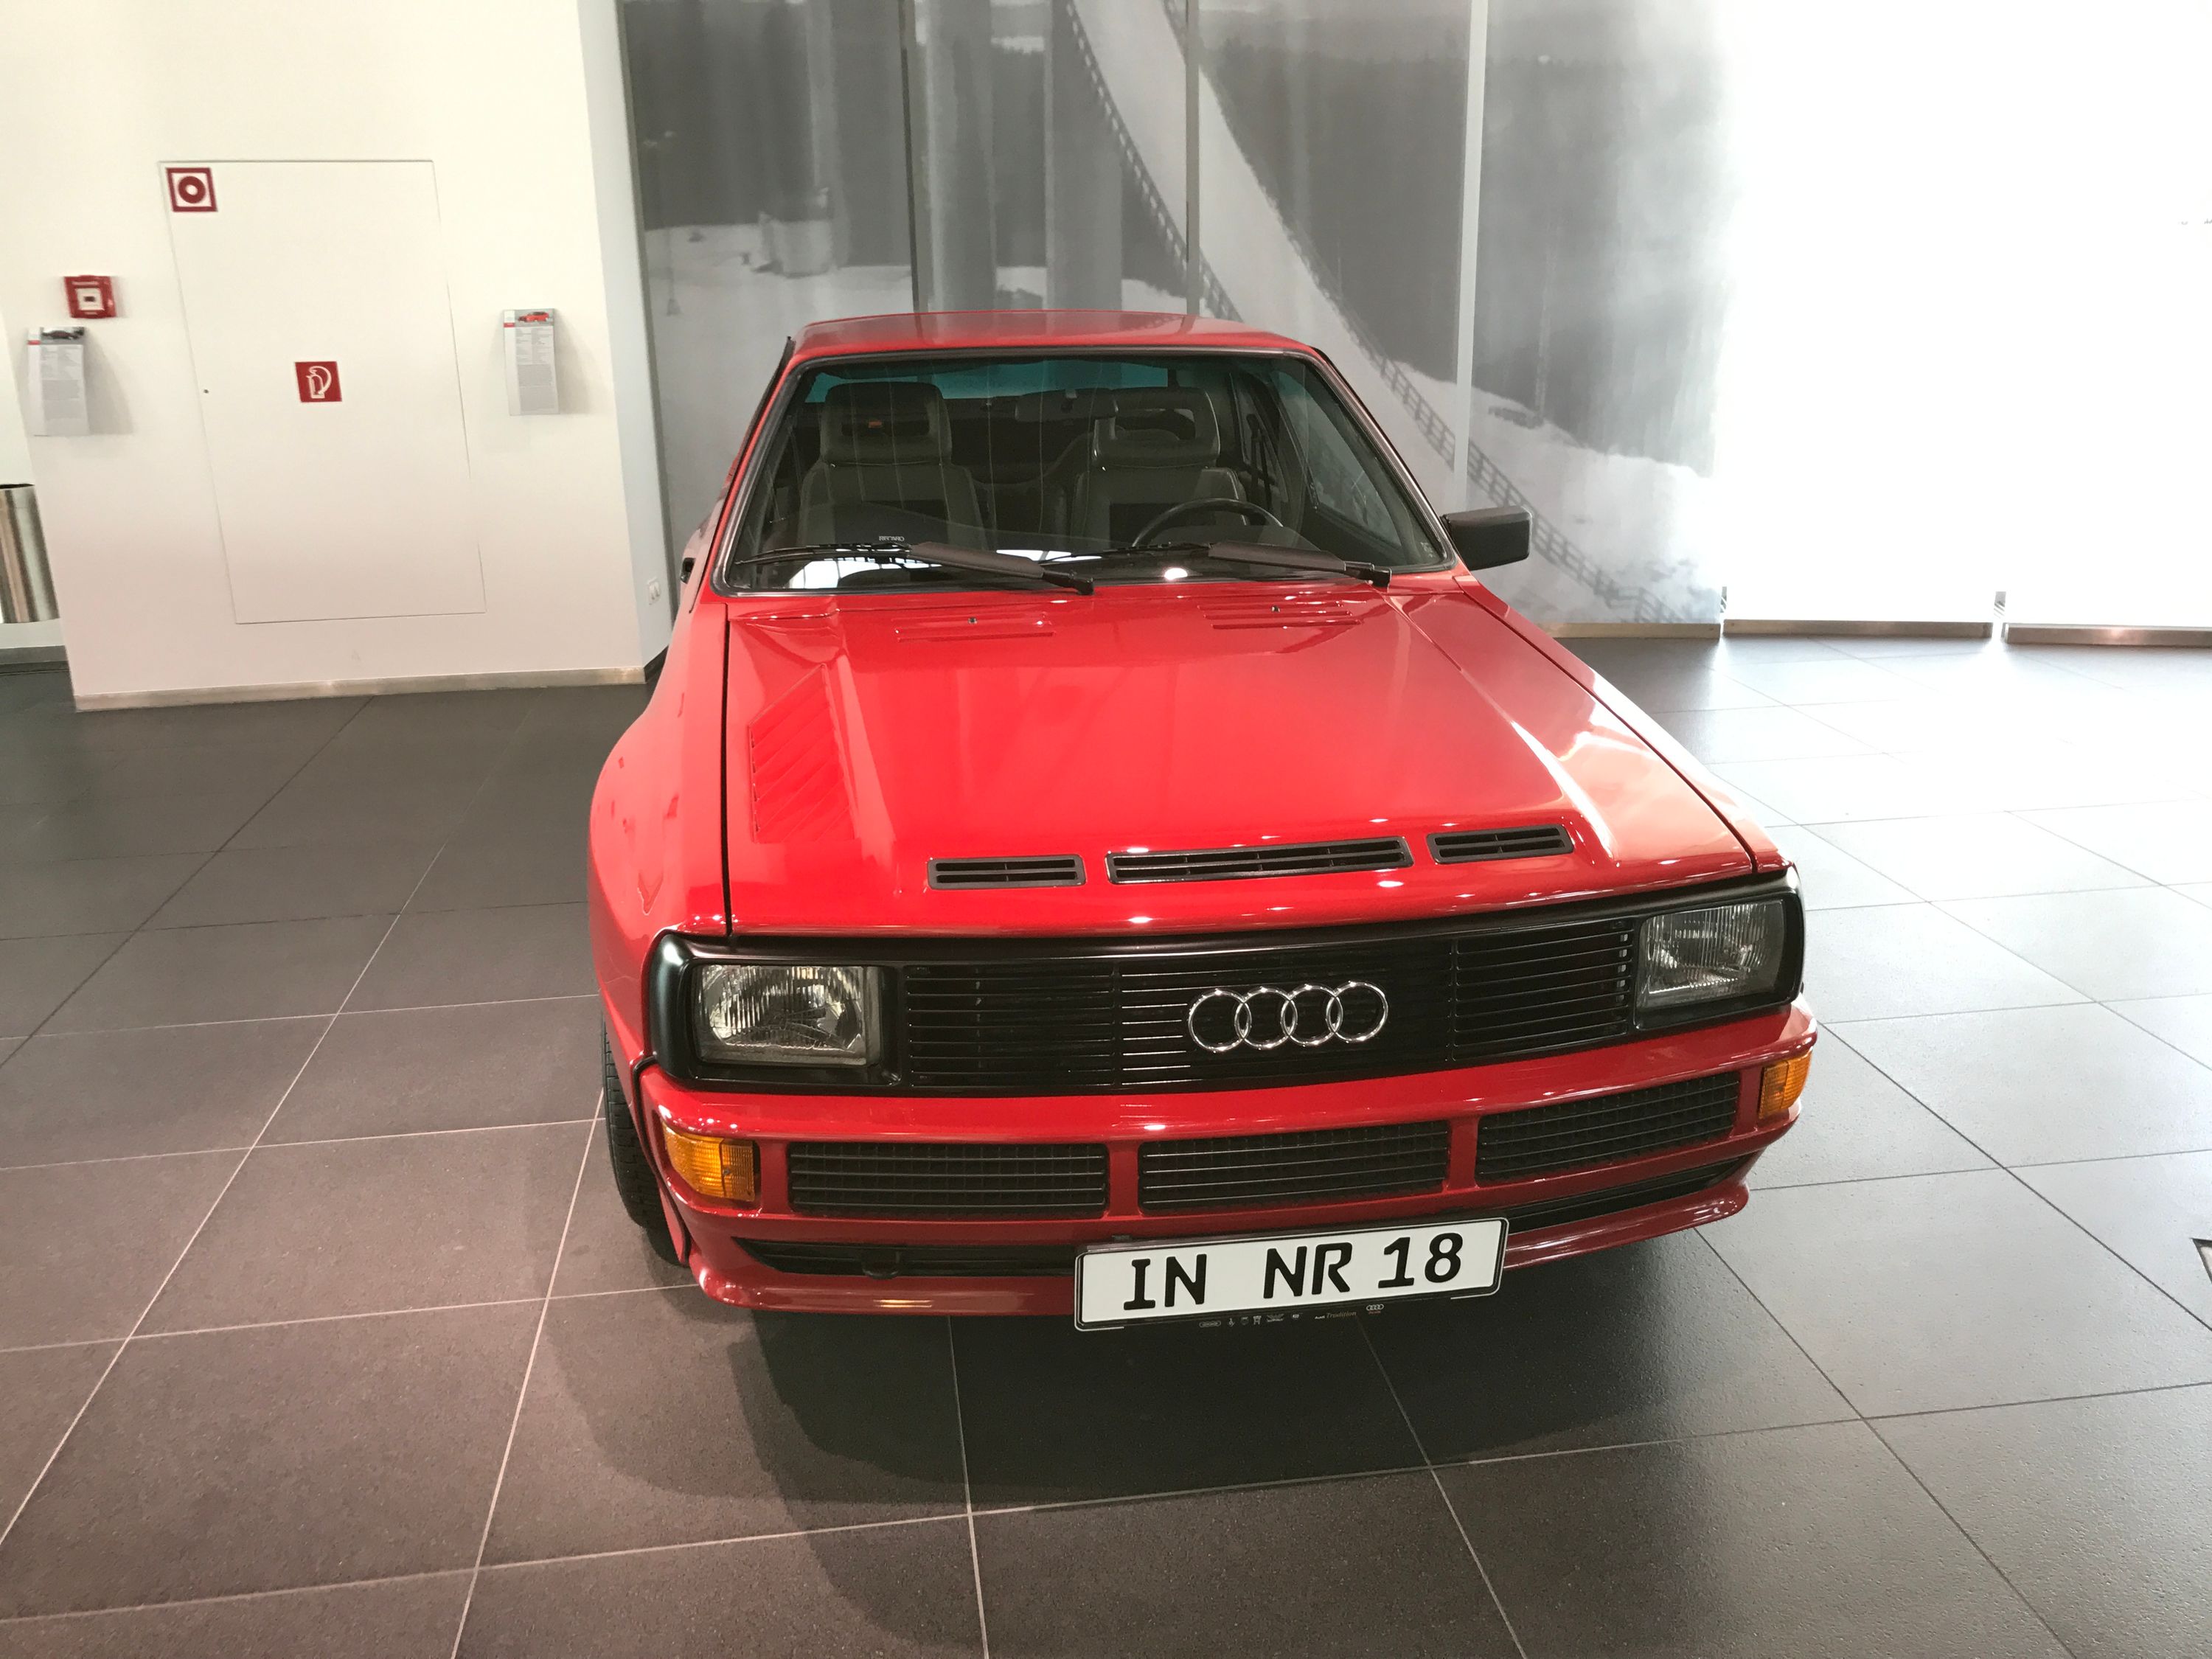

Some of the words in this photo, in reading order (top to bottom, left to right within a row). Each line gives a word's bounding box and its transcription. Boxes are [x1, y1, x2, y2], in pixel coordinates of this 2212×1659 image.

[1123, 1254, 1207, 1311] IN
[1263, 1242, 1353, 1299] NR
[1377, 1233, 1463, 1289] 18
[1326, 1311, 1357, 1319] Tradition
